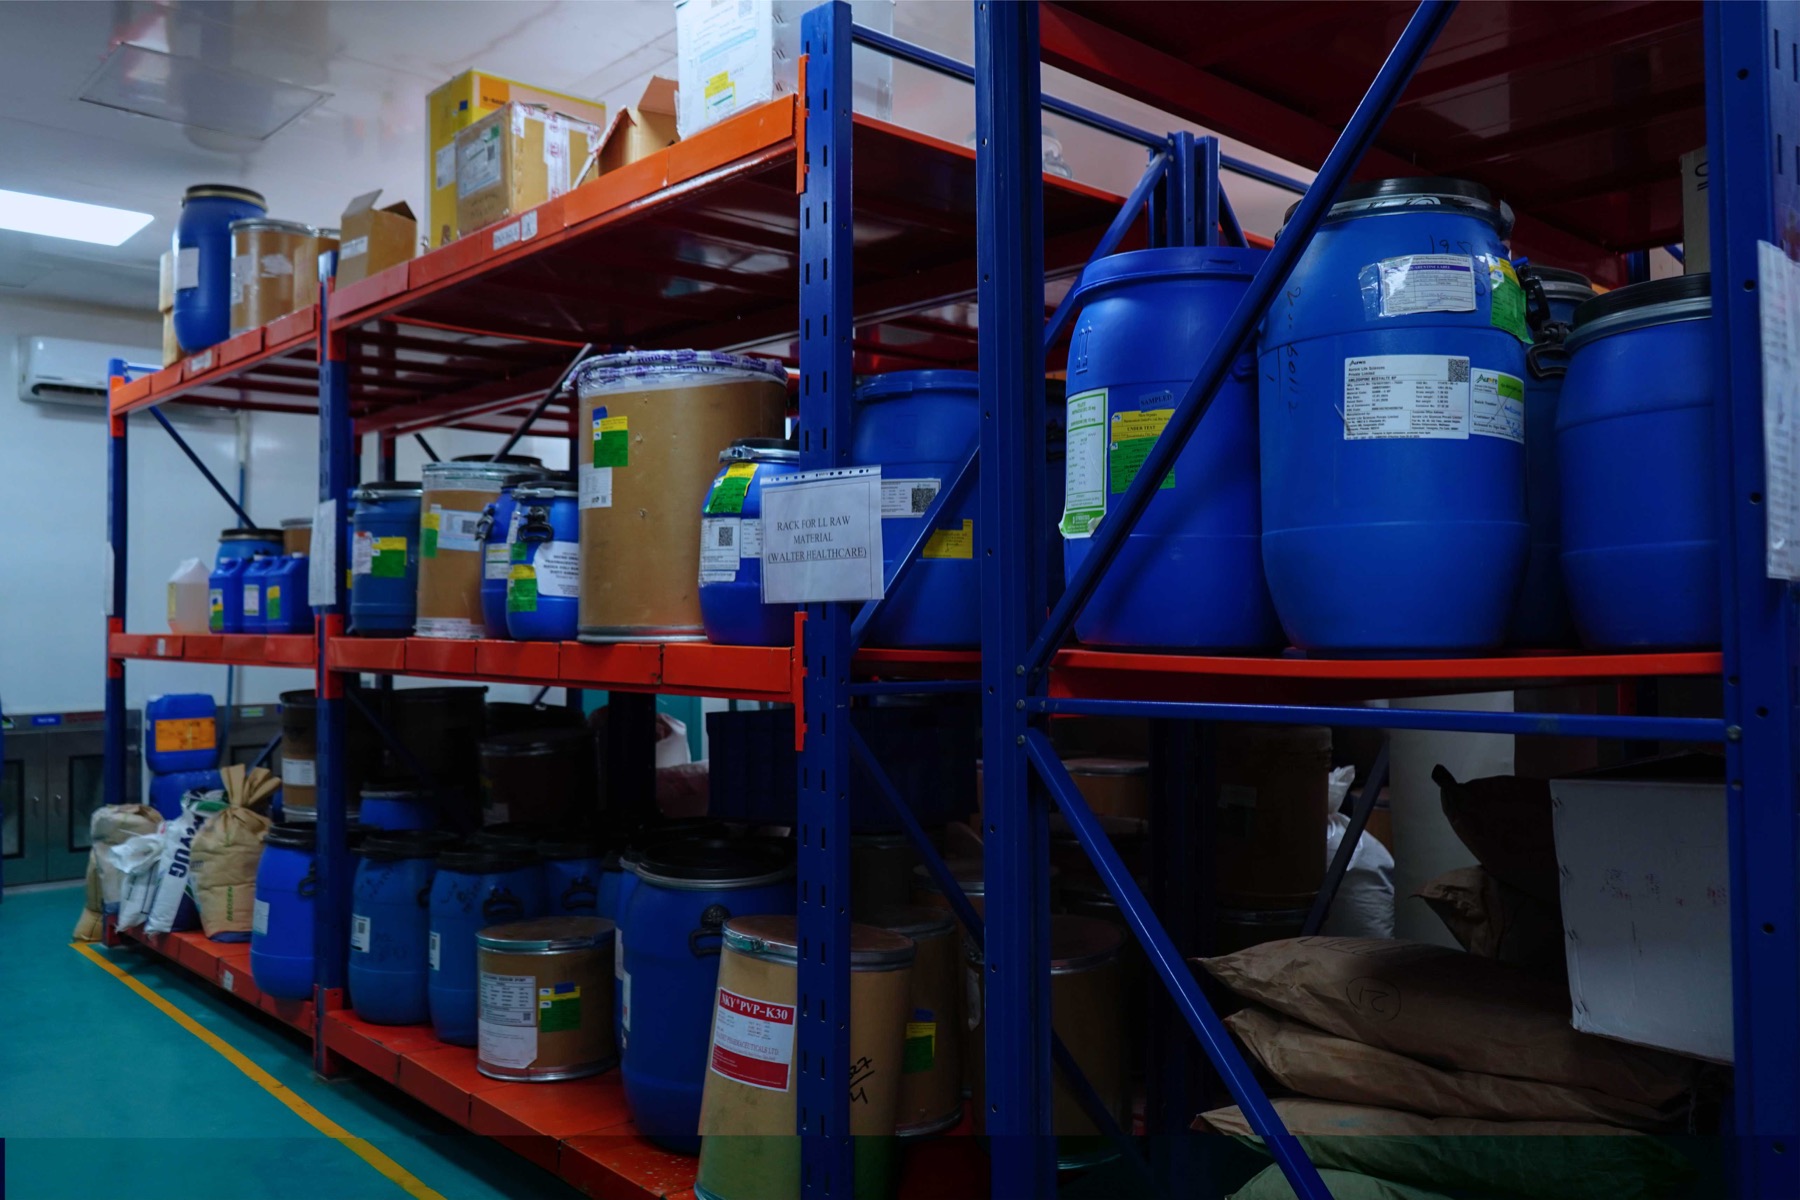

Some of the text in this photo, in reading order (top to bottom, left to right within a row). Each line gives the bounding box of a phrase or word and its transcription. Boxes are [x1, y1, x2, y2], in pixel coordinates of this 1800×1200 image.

[1141, 394, 1172, 406] SAMPLED
[777, 515, 851, 532] RACK FOR LL RAW
[793, 532, 834, 545] MATERIAL
[768, 546, 867, 564] (WALTER HEALTHCARE)
